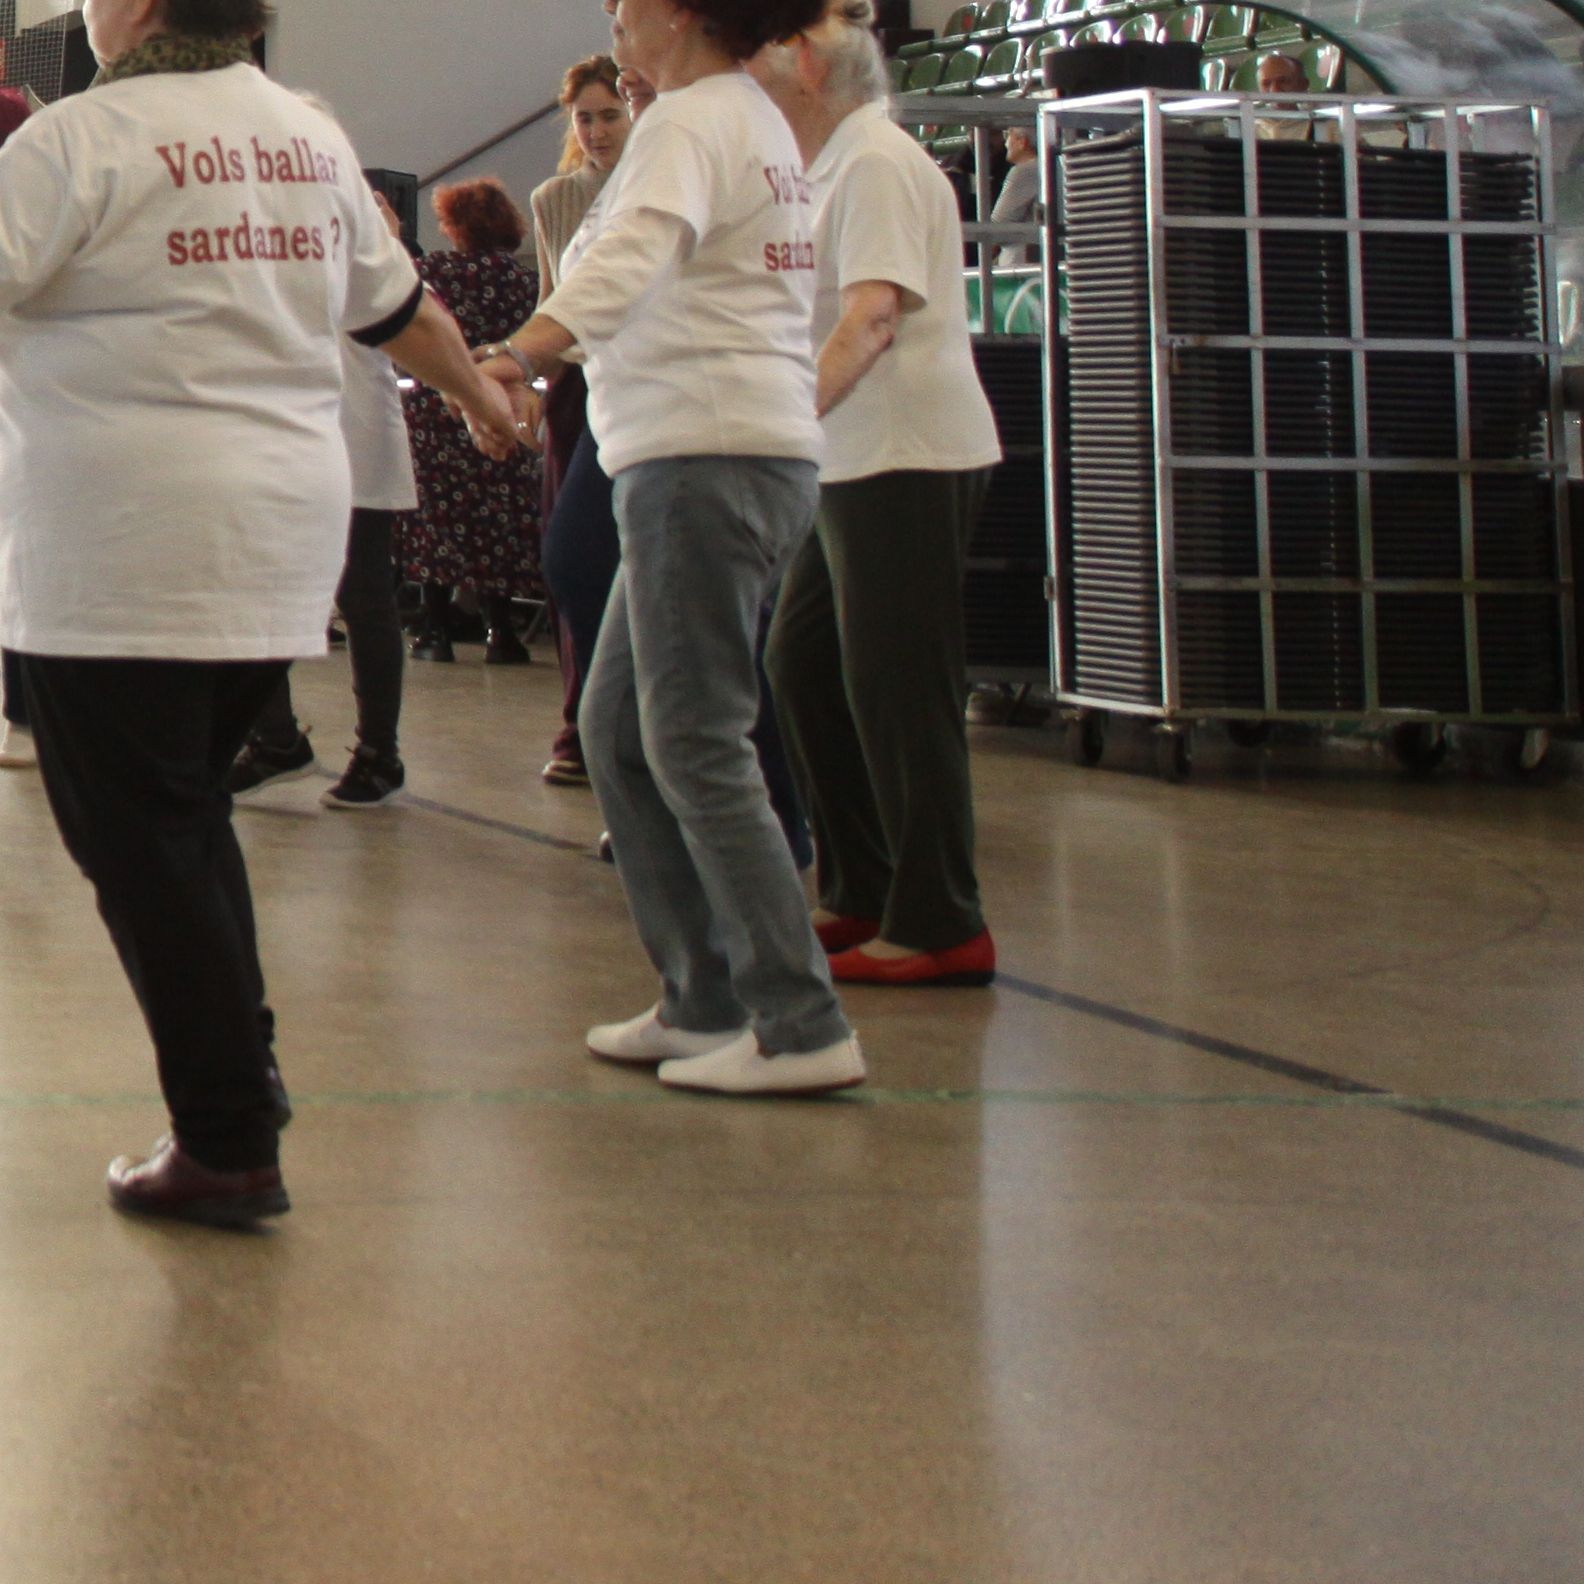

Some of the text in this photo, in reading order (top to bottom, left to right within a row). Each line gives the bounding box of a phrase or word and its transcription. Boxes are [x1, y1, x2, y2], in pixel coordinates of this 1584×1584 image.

[155, 135, 338, 188] Vols ballar
[167, 211, 340, 265] sardanes ?
